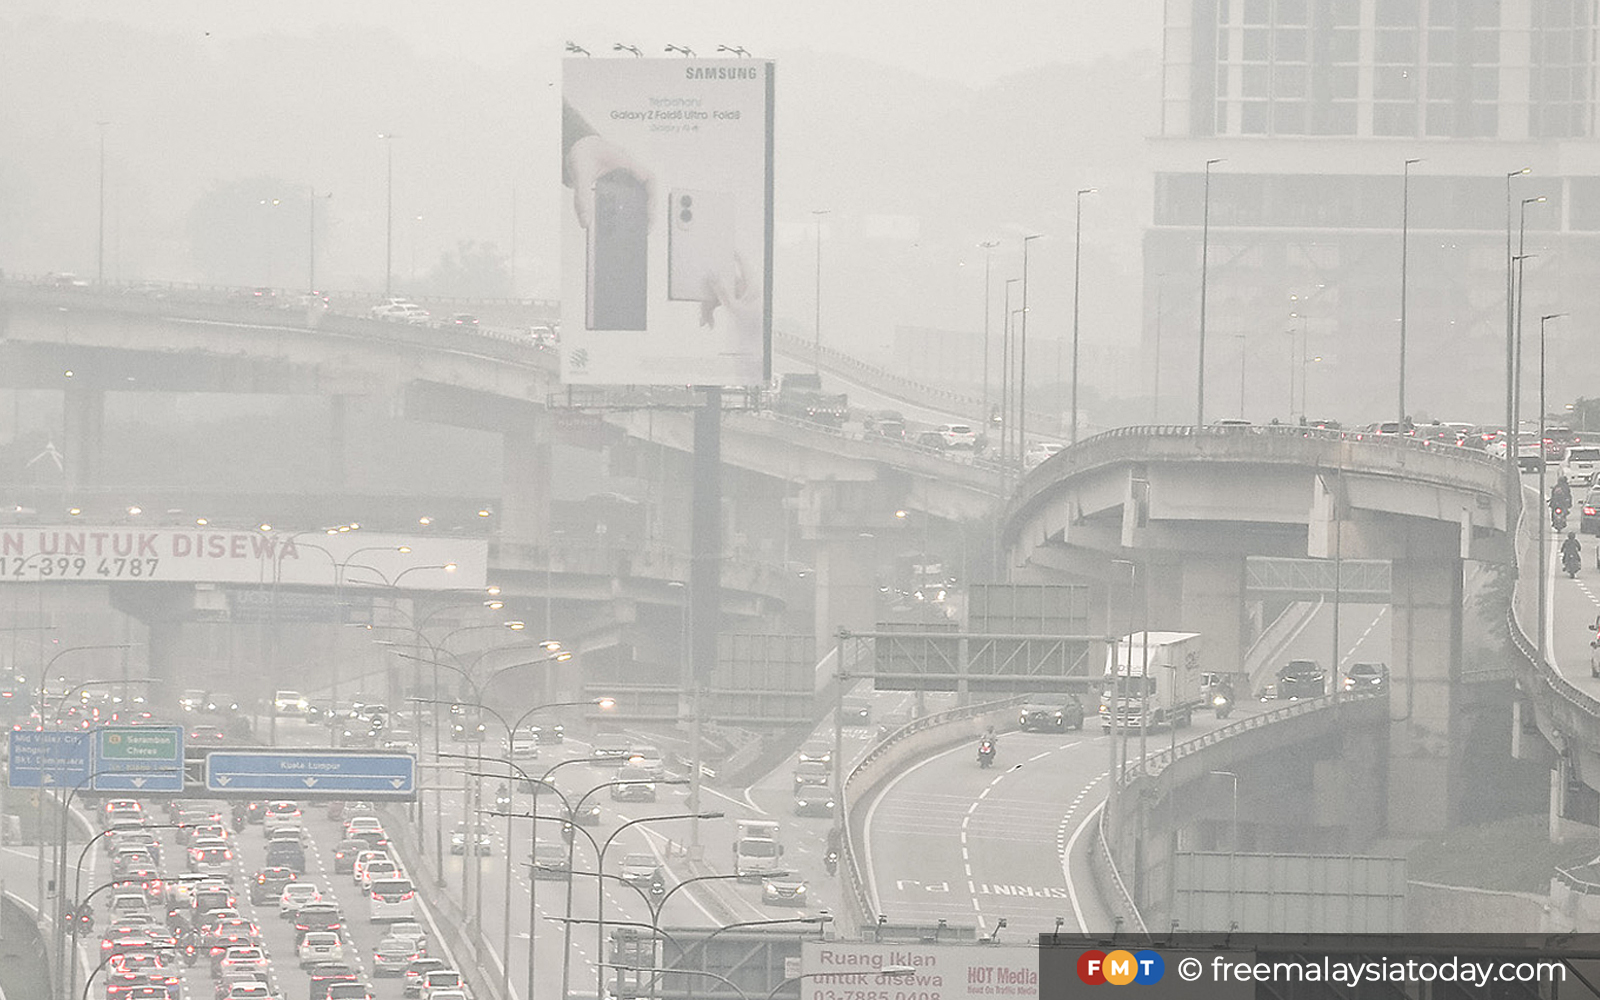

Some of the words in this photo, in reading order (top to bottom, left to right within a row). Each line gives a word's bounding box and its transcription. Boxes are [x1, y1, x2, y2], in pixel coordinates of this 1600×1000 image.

[685, 67, 757, 80] SAMSUNG
[610, 110, 646, 121] Galaxy
[647, 111, 654, 119] Z
[39, 532, 159, 557] UNTUK
[172, 533, 299, 560] DISEWA
[97, 558, 159, 577] 4787
[127, 747, 157, 755] Cheras
[281, 761, 305, 770] Kuala
[308, 762, 341, 771] Lumpur
[821, 951, 883, 968] Ruang
[890, 952, 936, 966] Iklan
[813, 973, 868, 985] untuk
[968, 967, 993, 984] HOT
[997, 967, 1037, 985] Media
